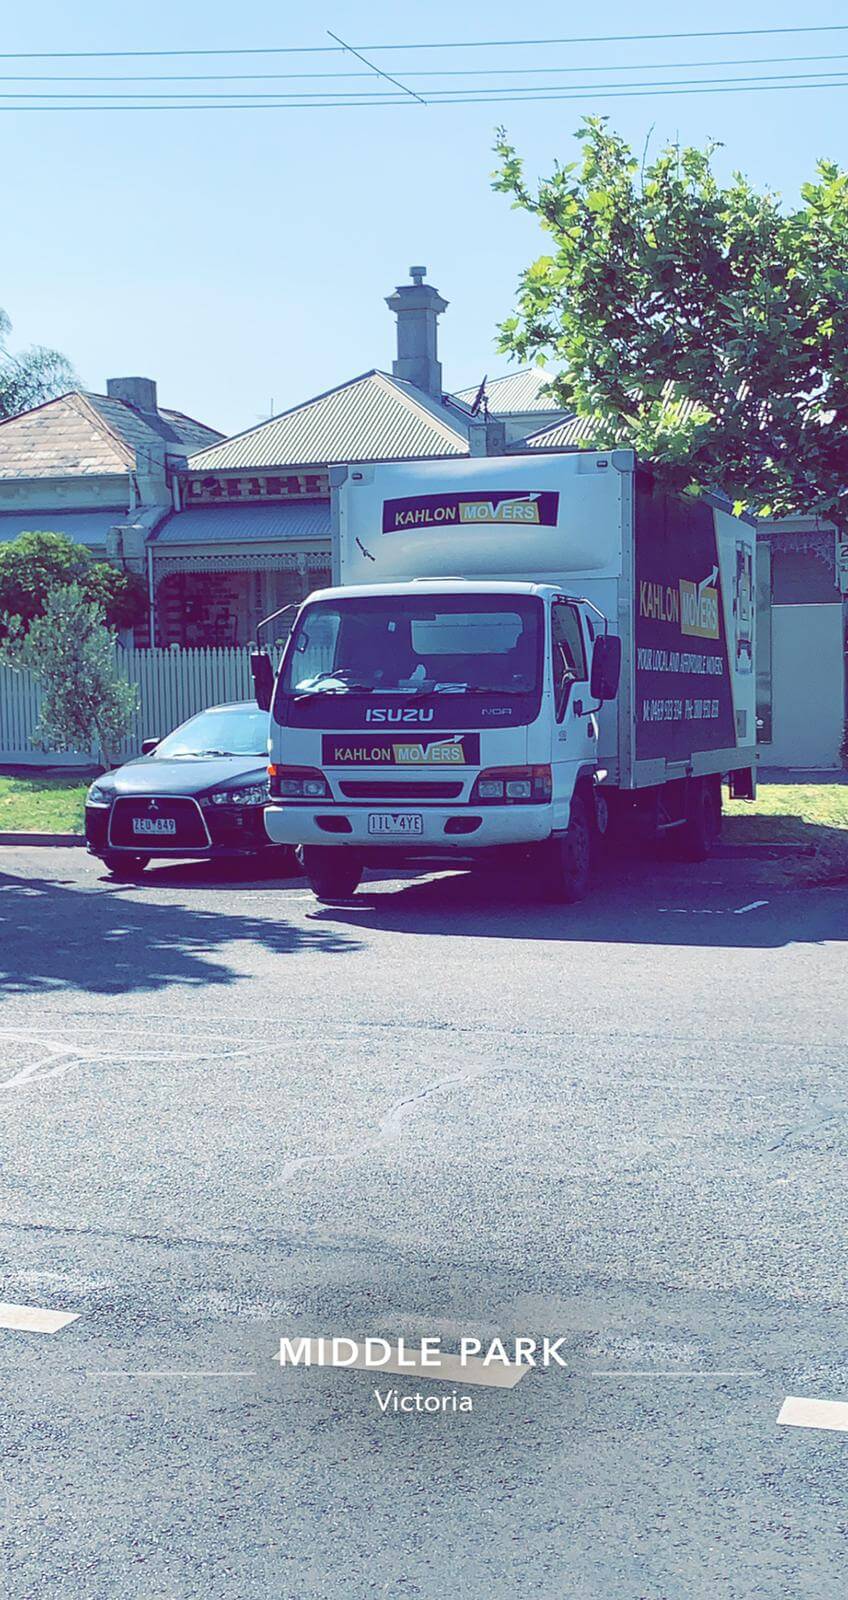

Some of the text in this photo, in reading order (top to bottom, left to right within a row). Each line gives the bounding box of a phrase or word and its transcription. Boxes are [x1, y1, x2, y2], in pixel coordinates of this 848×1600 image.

[395, 502, 535, 525] KAHLON MOVERS
[640, 580, 717, 631] KAHLON MOVERS
[637, 648, 652, 670] YOUR
[653, 650, 669, 672] LOCAL
[365, 709, 434, 722] ISUZU
[334, 744, 461, 761] KAHLON MOVERS
[157, 819, 174, 830] 849
[400, 817, 420, 829] 4YE
